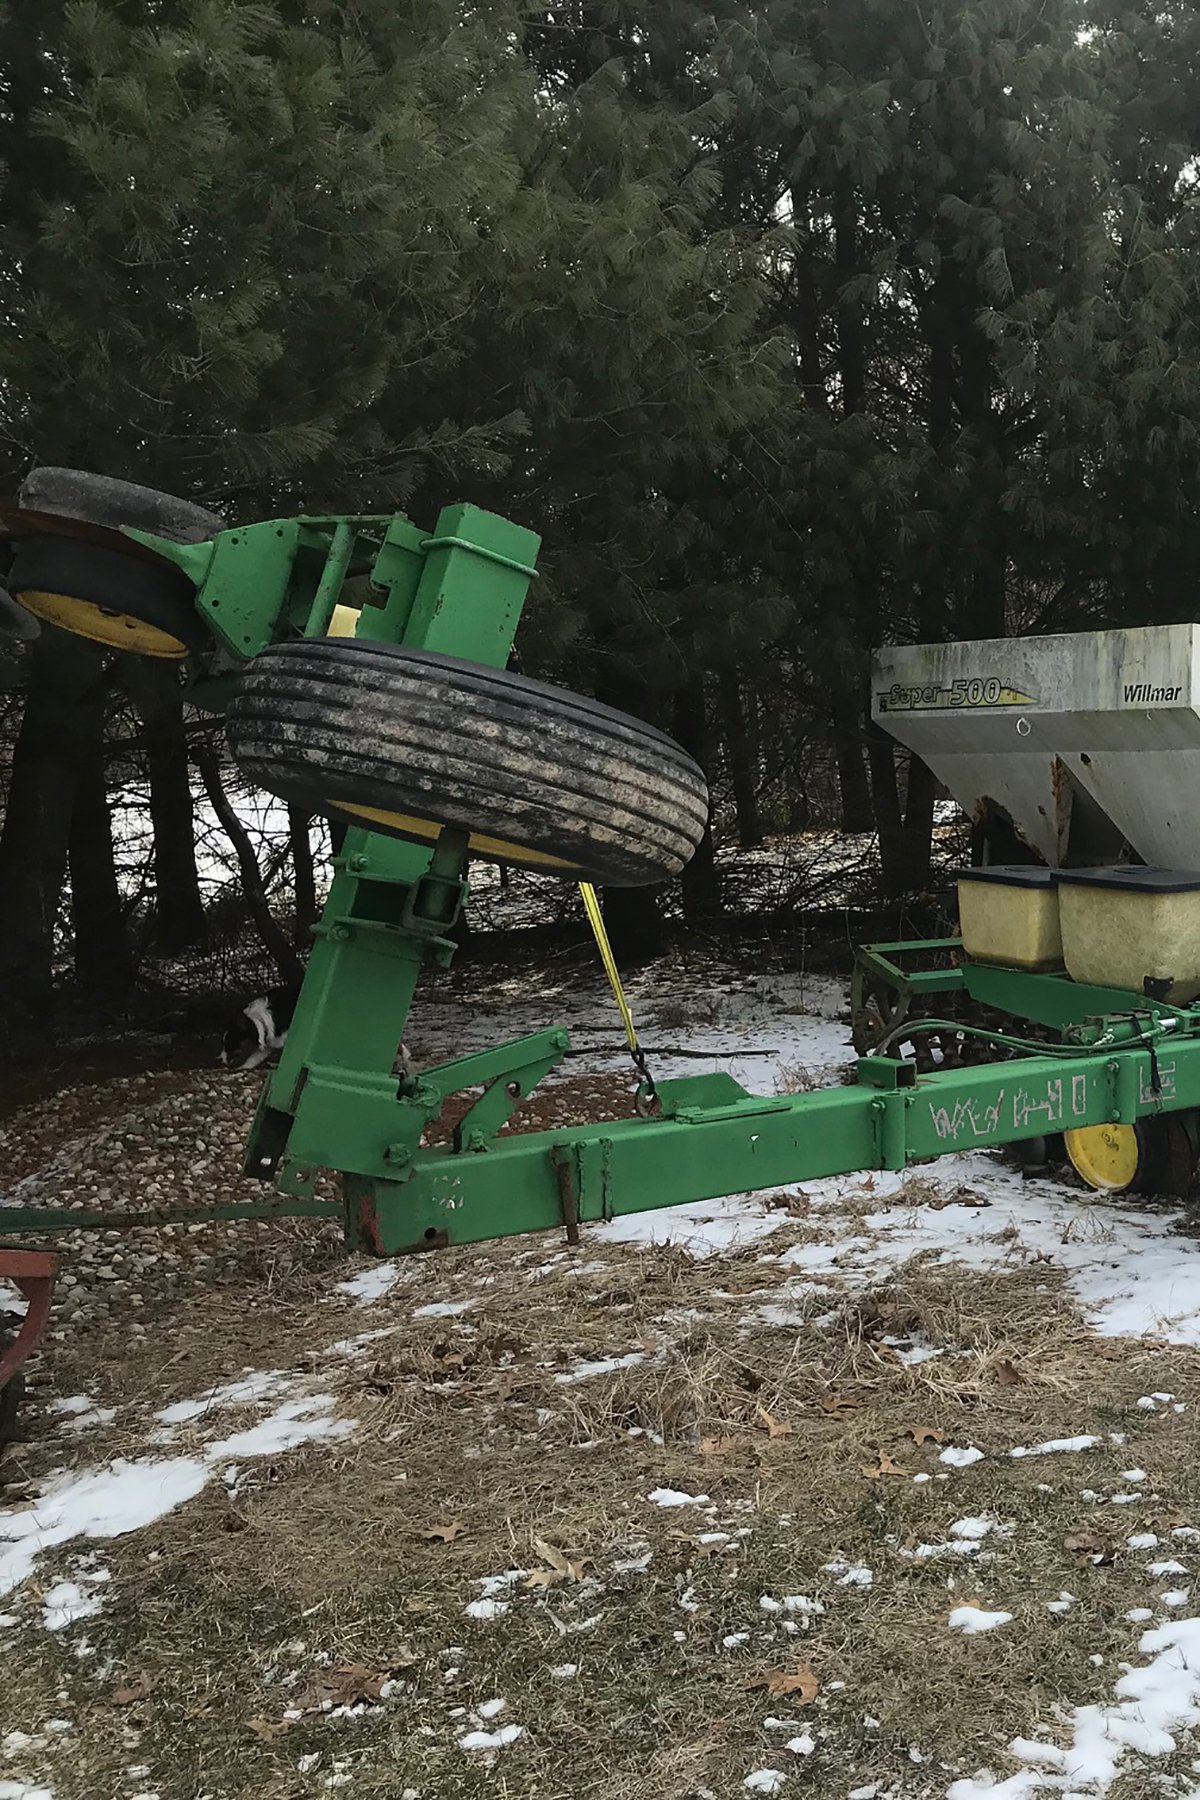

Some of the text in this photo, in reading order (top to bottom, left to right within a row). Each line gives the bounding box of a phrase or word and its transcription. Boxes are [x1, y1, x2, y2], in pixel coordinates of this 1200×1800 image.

[890, 677, 1001, 710] Super 500
[1124, 684, 1182, 703] Willmar
